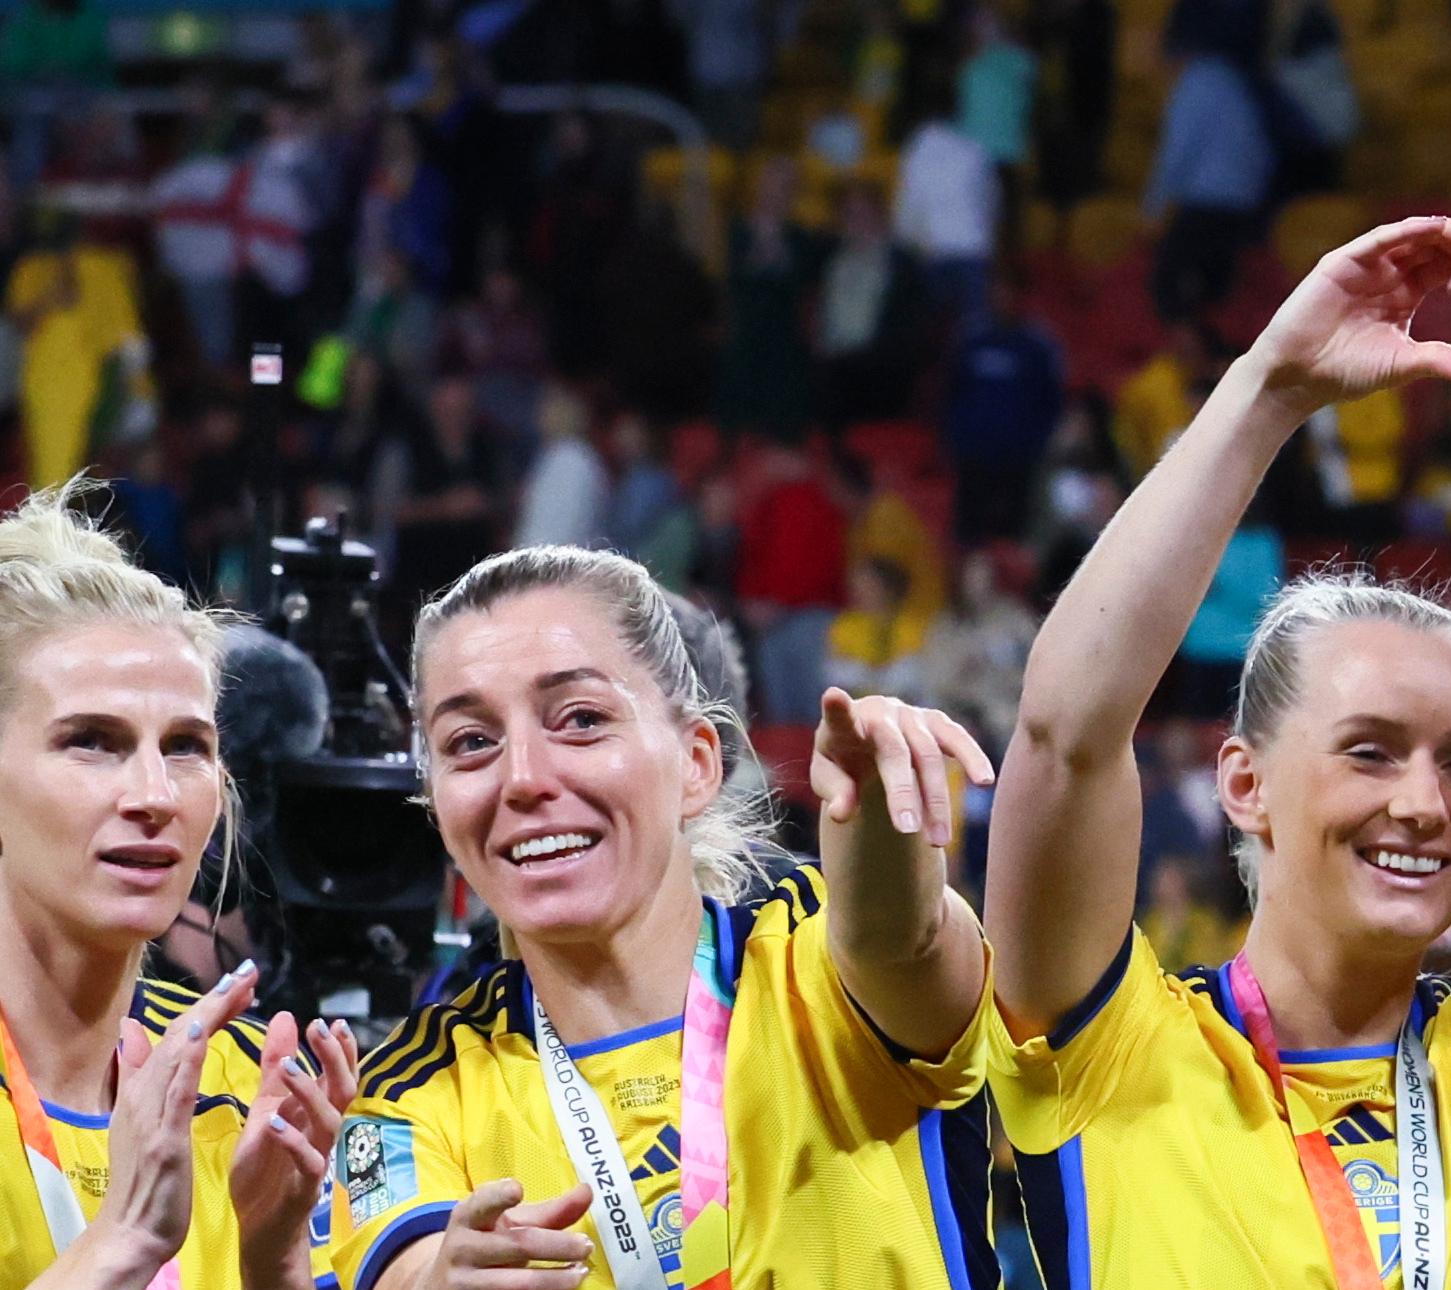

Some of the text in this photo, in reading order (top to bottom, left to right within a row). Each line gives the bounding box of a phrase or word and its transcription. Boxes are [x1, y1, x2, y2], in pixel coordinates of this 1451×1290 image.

[541, 1015, 575, 1084] WORLD
[564, 1085, 590, 1124] CUP
[1411, 1113, 1427, 1178] WORLD
[1356, 1197, 1394, 1207] ERIGE
[1413, 1181, 1429, 1219] CUP
